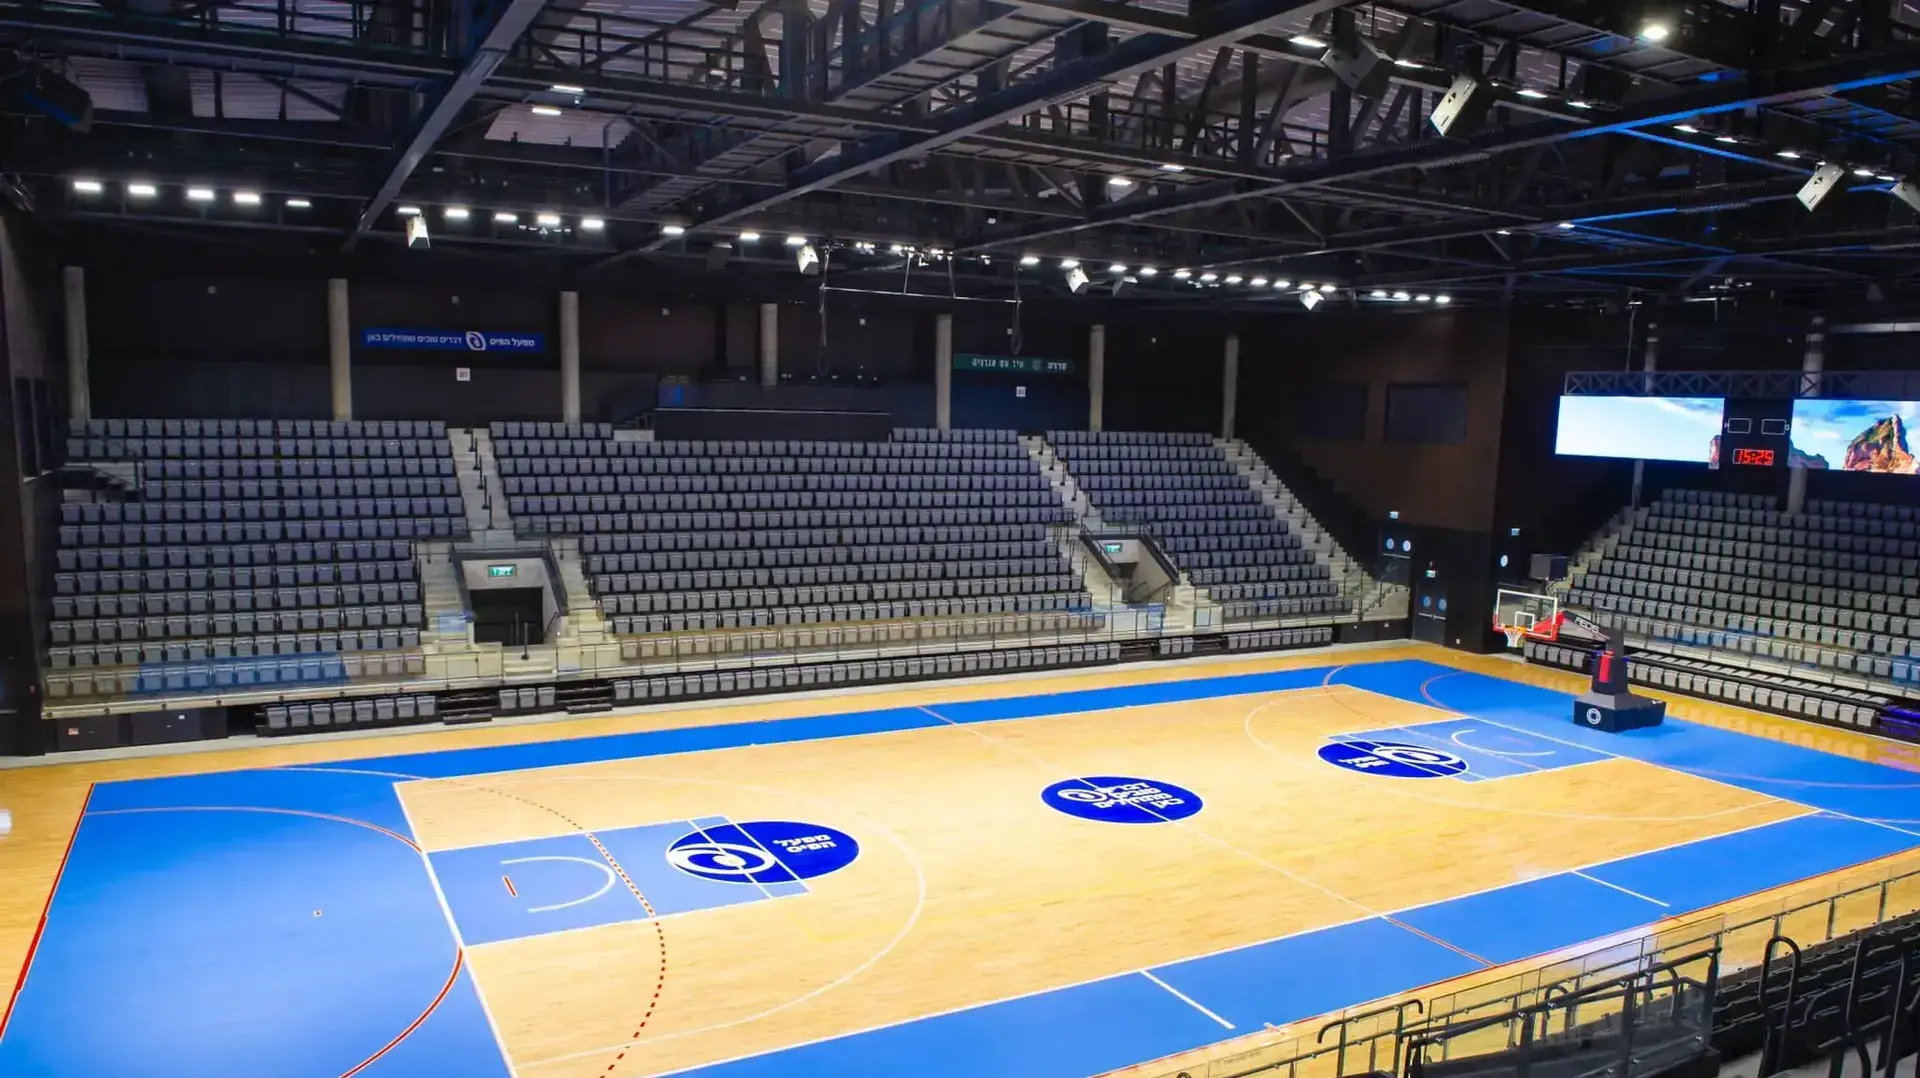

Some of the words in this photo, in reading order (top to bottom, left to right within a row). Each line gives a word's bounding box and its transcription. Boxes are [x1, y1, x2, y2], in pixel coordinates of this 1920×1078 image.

[439, 335, 462, 344] דברים
[489, 338, 511, 346] הפיס
[511, 337, 535, 347] מפעל
[1737, 449, 1774, 465] 15:25
[772, 834, 832, 848] מפעל
[785, 840, 837, 854] הפיס
